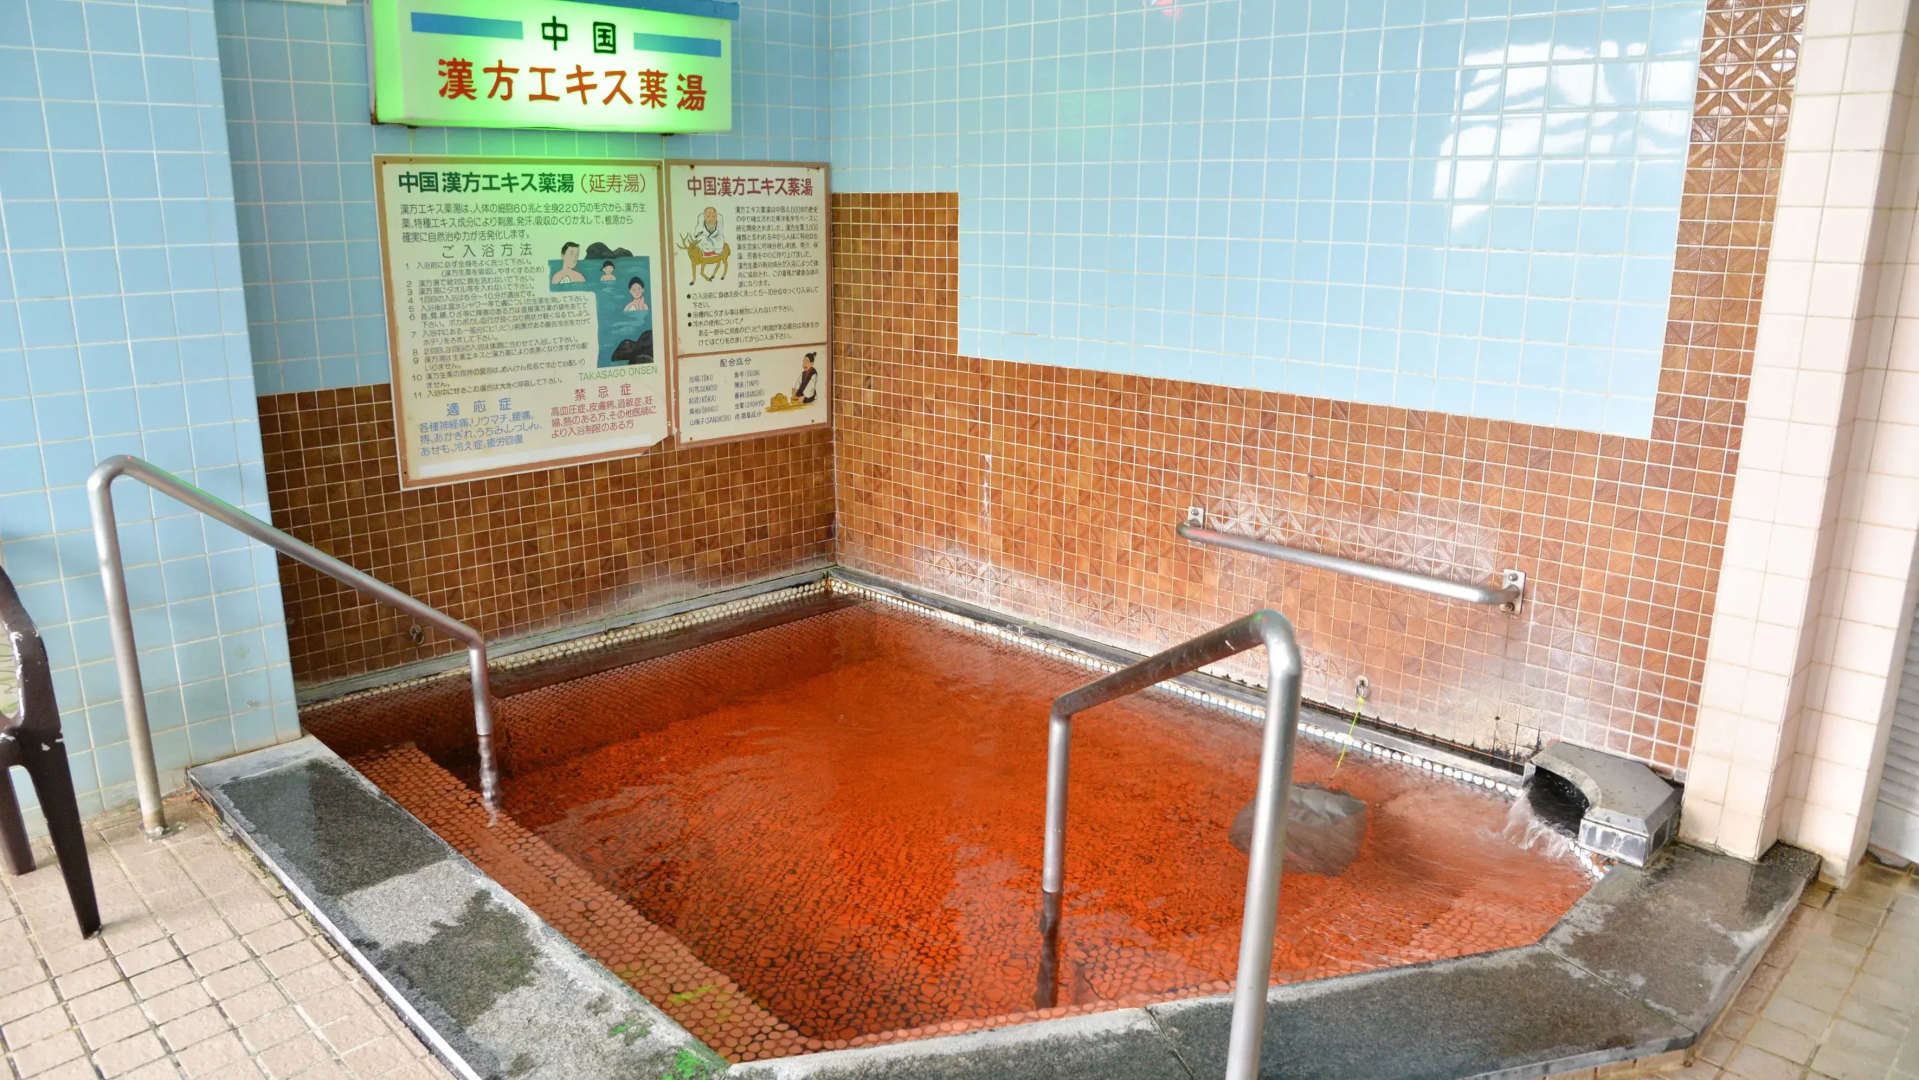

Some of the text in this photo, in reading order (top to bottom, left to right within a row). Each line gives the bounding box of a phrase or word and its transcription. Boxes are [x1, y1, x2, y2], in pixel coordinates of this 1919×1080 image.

[541, 15, 617, 54] 中国
[437, 57, 708, 112] 漢方エキス薬湯
[687, 175, 813, 197] 中国漢方エキス薬湯
[577, 364, 658, 382] TAKASAGO ONSEN
[574, 383, 632, 402] 禁忌症
[446, 396, 512, 417] 適応症
[551, 419, 634, 439] より入浴制限のある方
